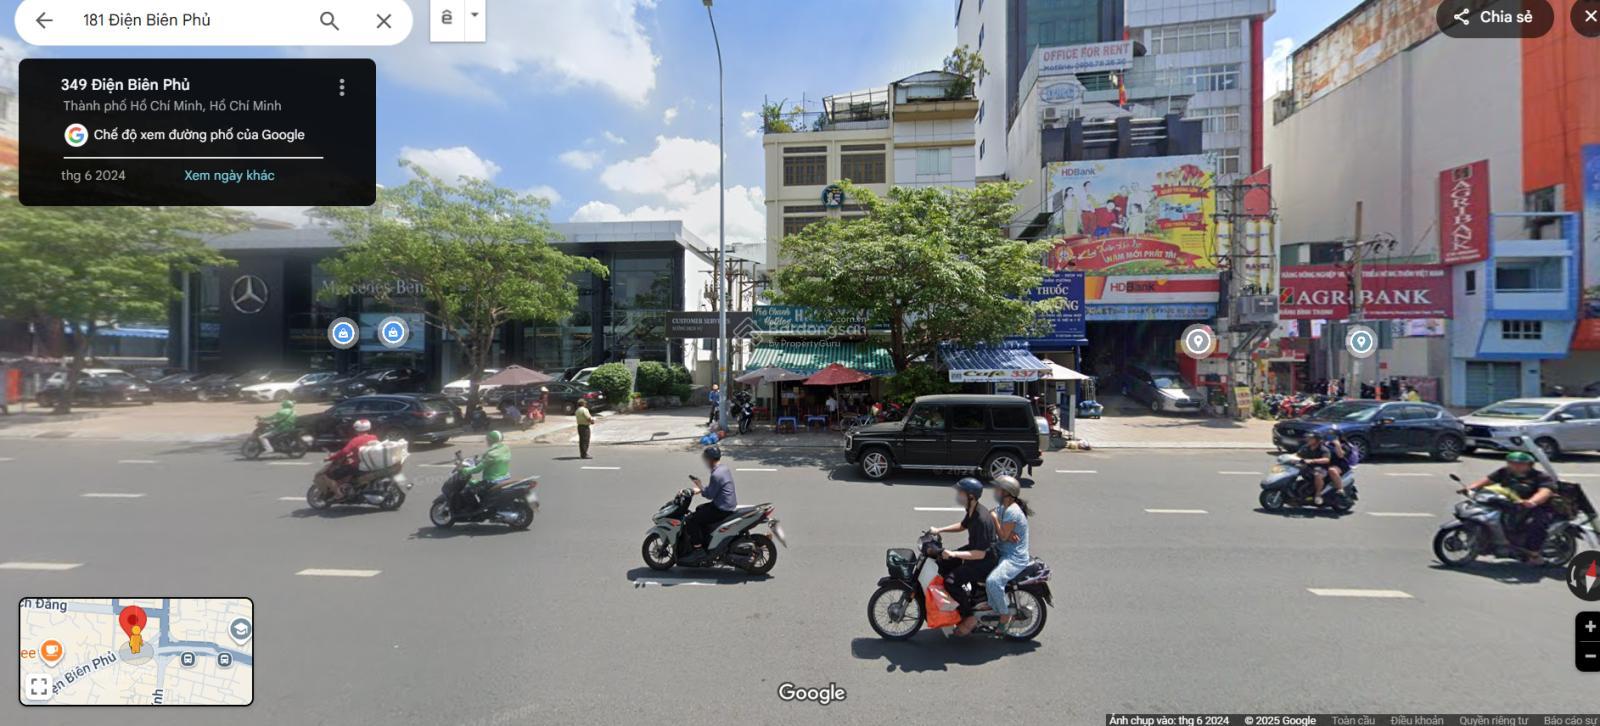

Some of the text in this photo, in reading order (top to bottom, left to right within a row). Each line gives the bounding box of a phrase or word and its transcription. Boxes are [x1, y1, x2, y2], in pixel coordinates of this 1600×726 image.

[1043, 43, 1129, 61] OFFICE FOR RENT
[1061, 168, 1096, 176] HDBank
[1450, 180, 1473, 250] AGRIBANK
[1036, 283, 1069, 295] THUỐC
[1110, 281, 1153, 292] HDBank
